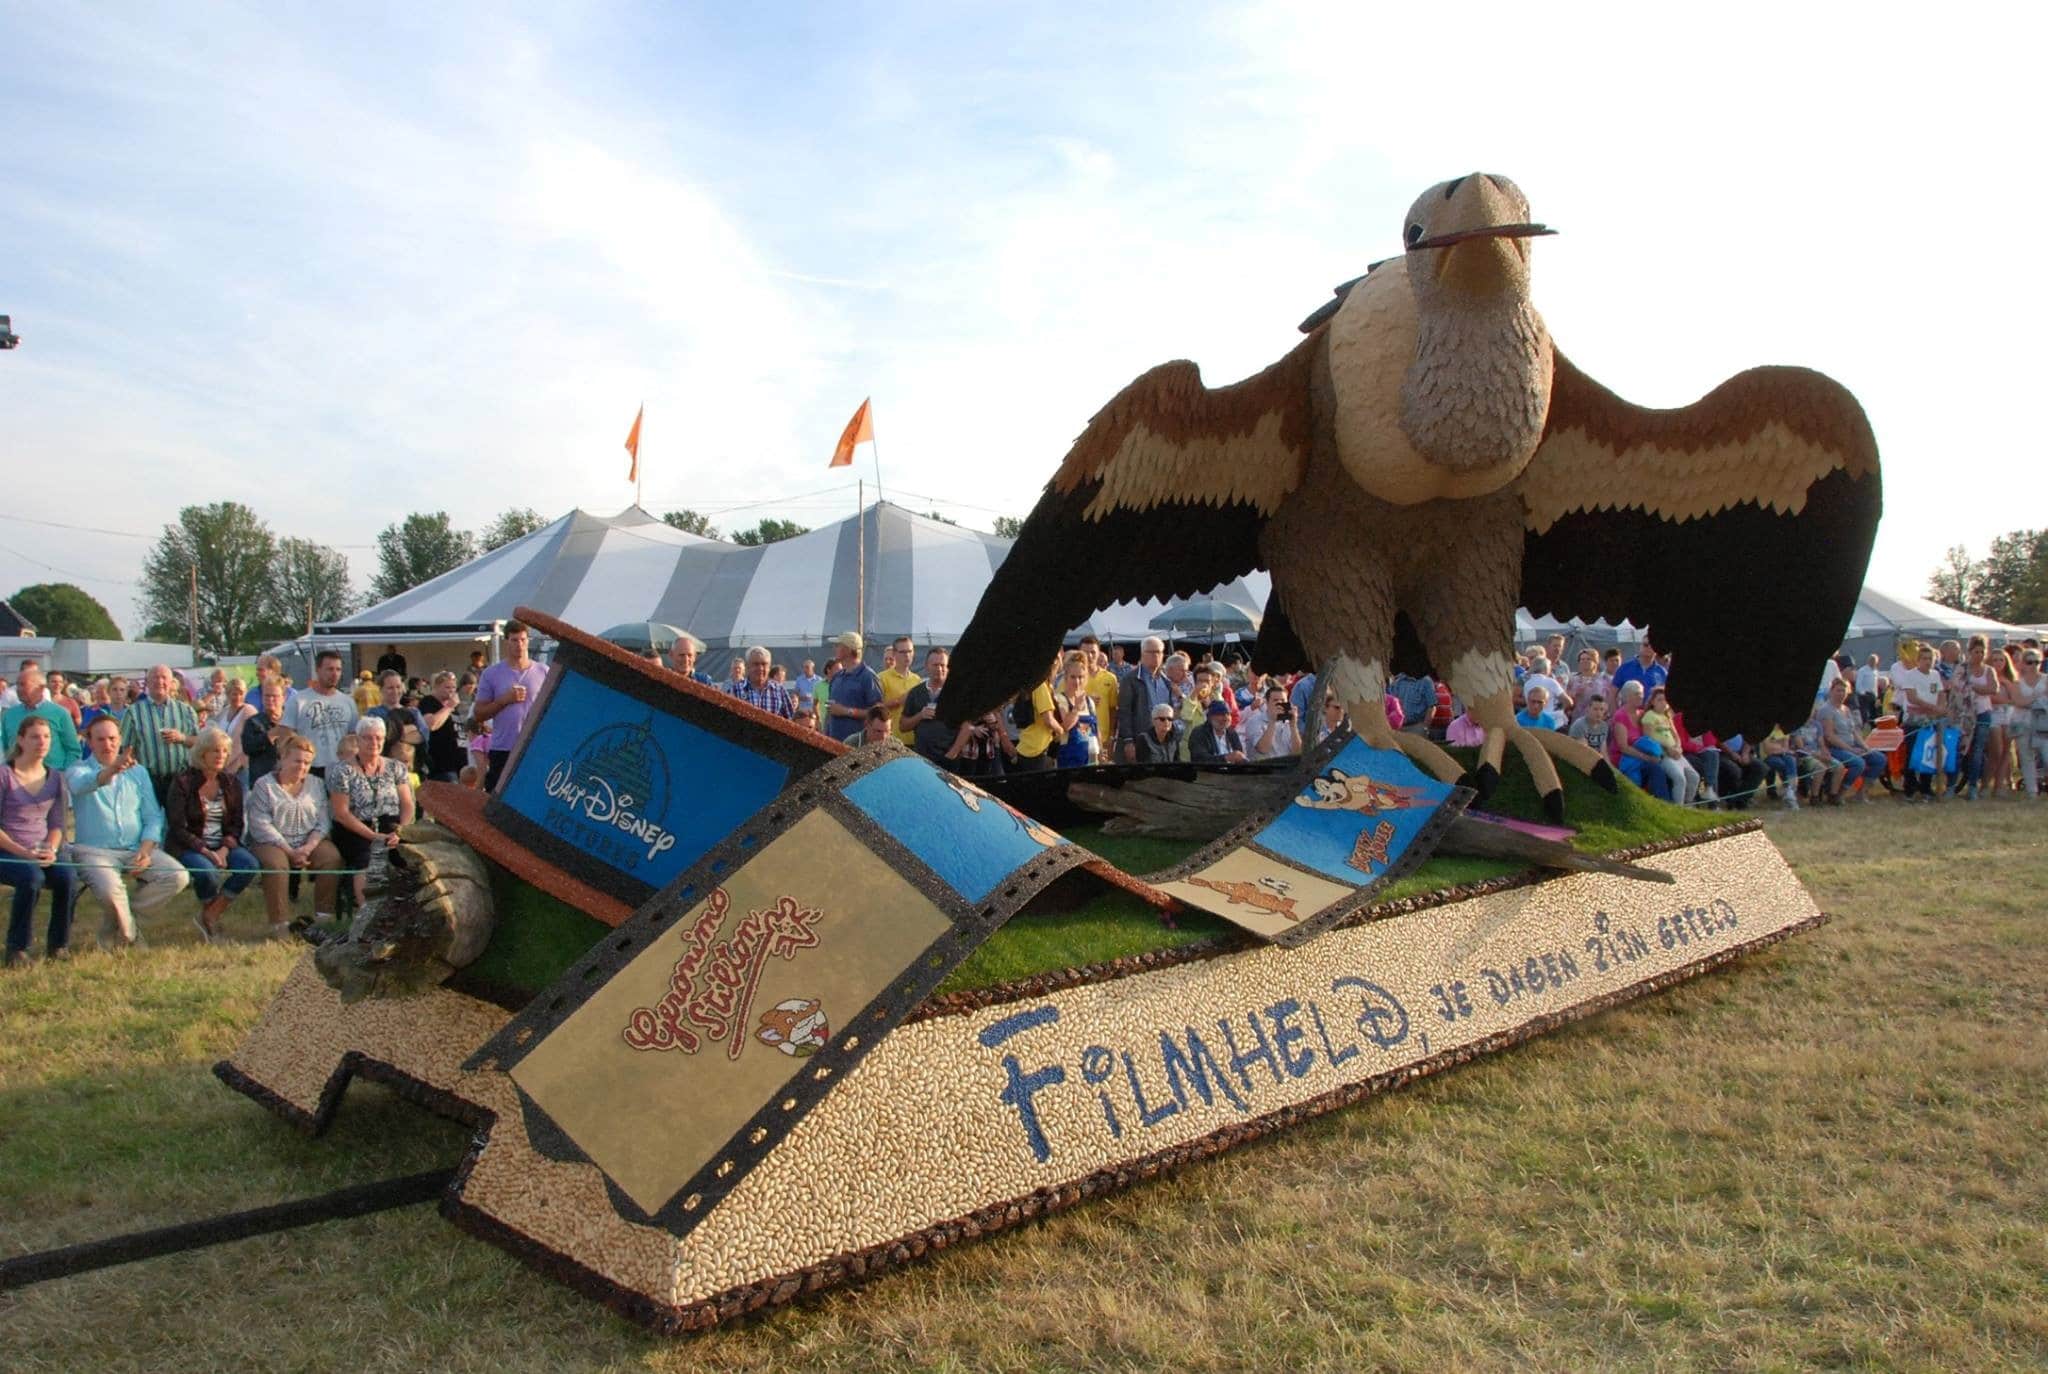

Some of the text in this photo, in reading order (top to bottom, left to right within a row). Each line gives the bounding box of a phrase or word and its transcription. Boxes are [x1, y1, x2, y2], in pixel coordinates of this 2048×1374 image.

[1369, 820, 1396, 865] MOUSE
[624, 887, 729, 1054] Geronimo
[688, 909, 761, 1041] Stilton
[1430, 979, 1474, 1022] JE
[1480, 949, 1580, 1006] DAGEN
[1658, 899, 1738, 950] GETELD
